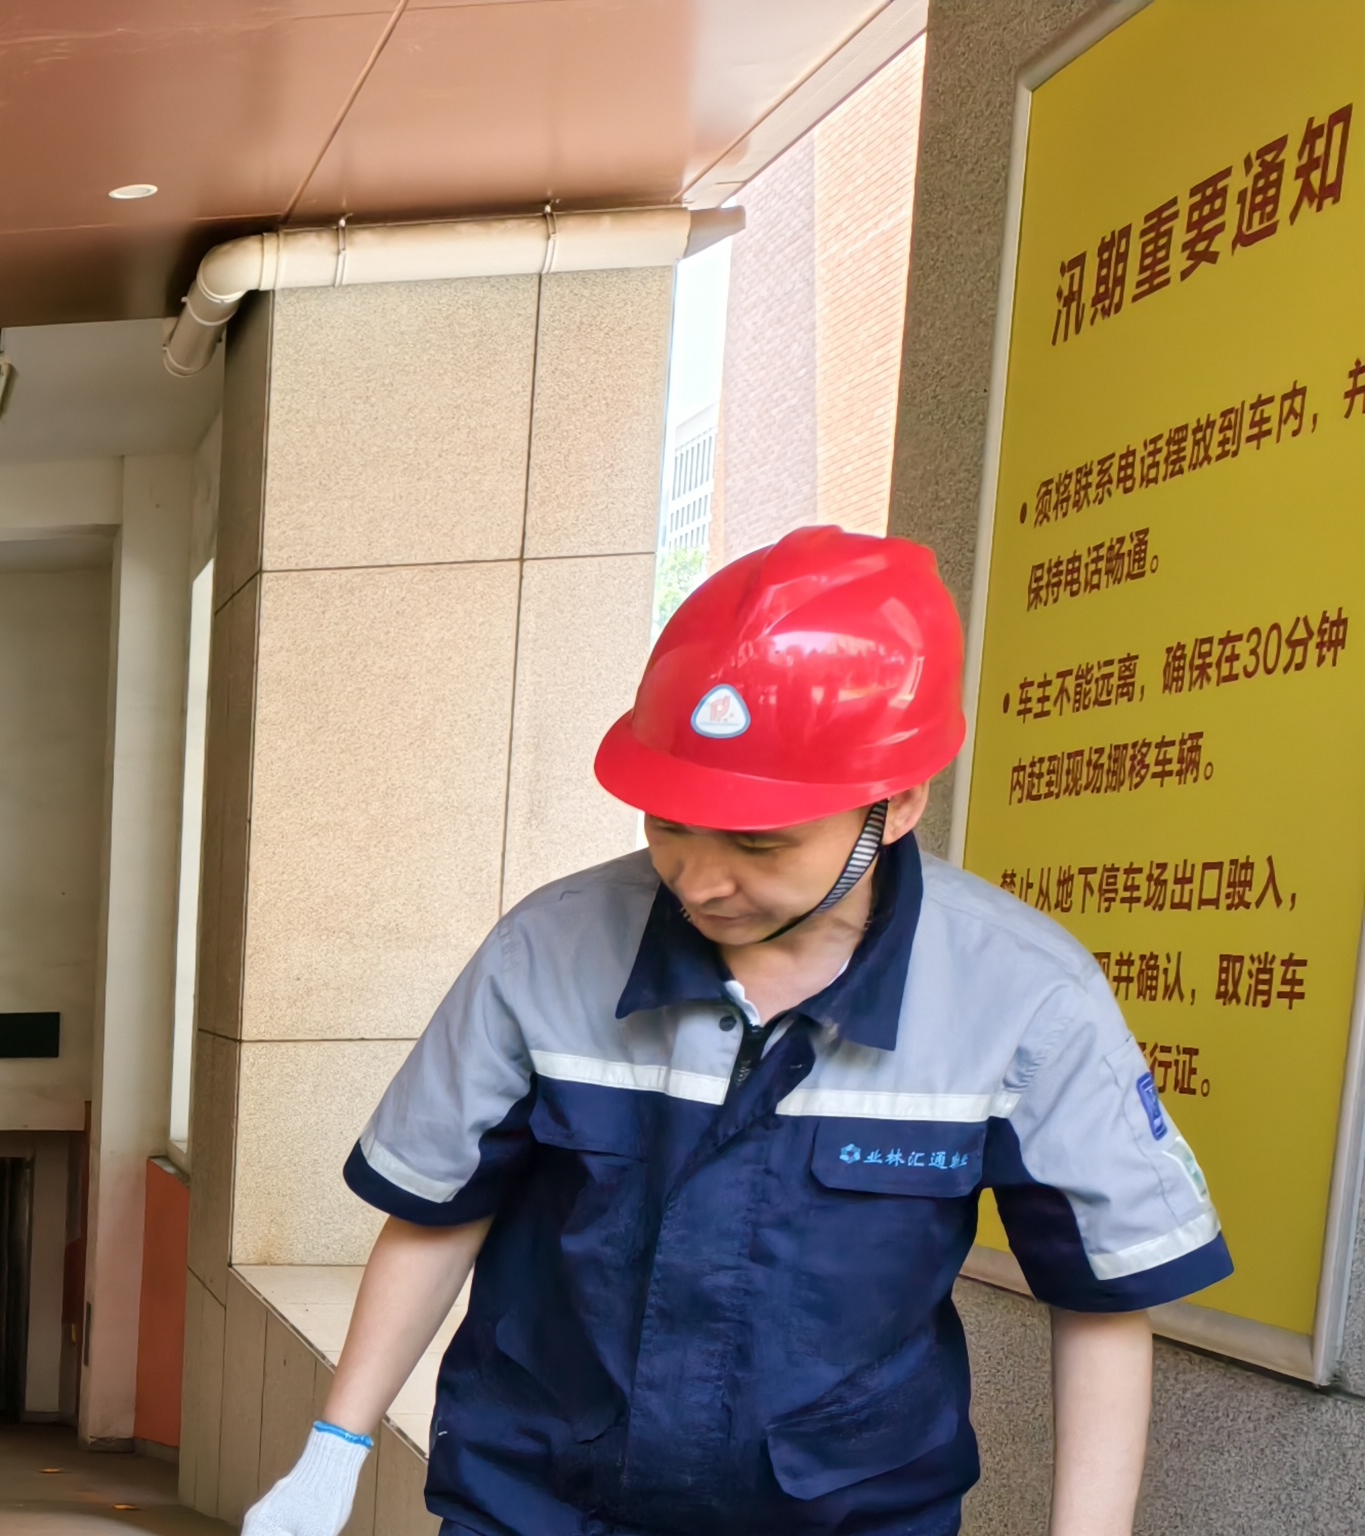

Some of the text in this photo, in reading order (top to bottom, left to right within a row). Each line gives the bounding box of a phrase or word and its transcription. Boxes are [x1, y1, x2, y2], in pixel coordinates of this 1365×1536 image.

[1051, 102, 1353, 347] 汛期重要通知
[1026, 527, 1159, 612] 保持电话畅通。
[1016, 607, 1349, 724] 车主不能远离，确保在30分钟
[1009, 731, 1214, 805] 内赶到现场挪移车辆。
[1137, 1041, 1210, 1098] 行证。
